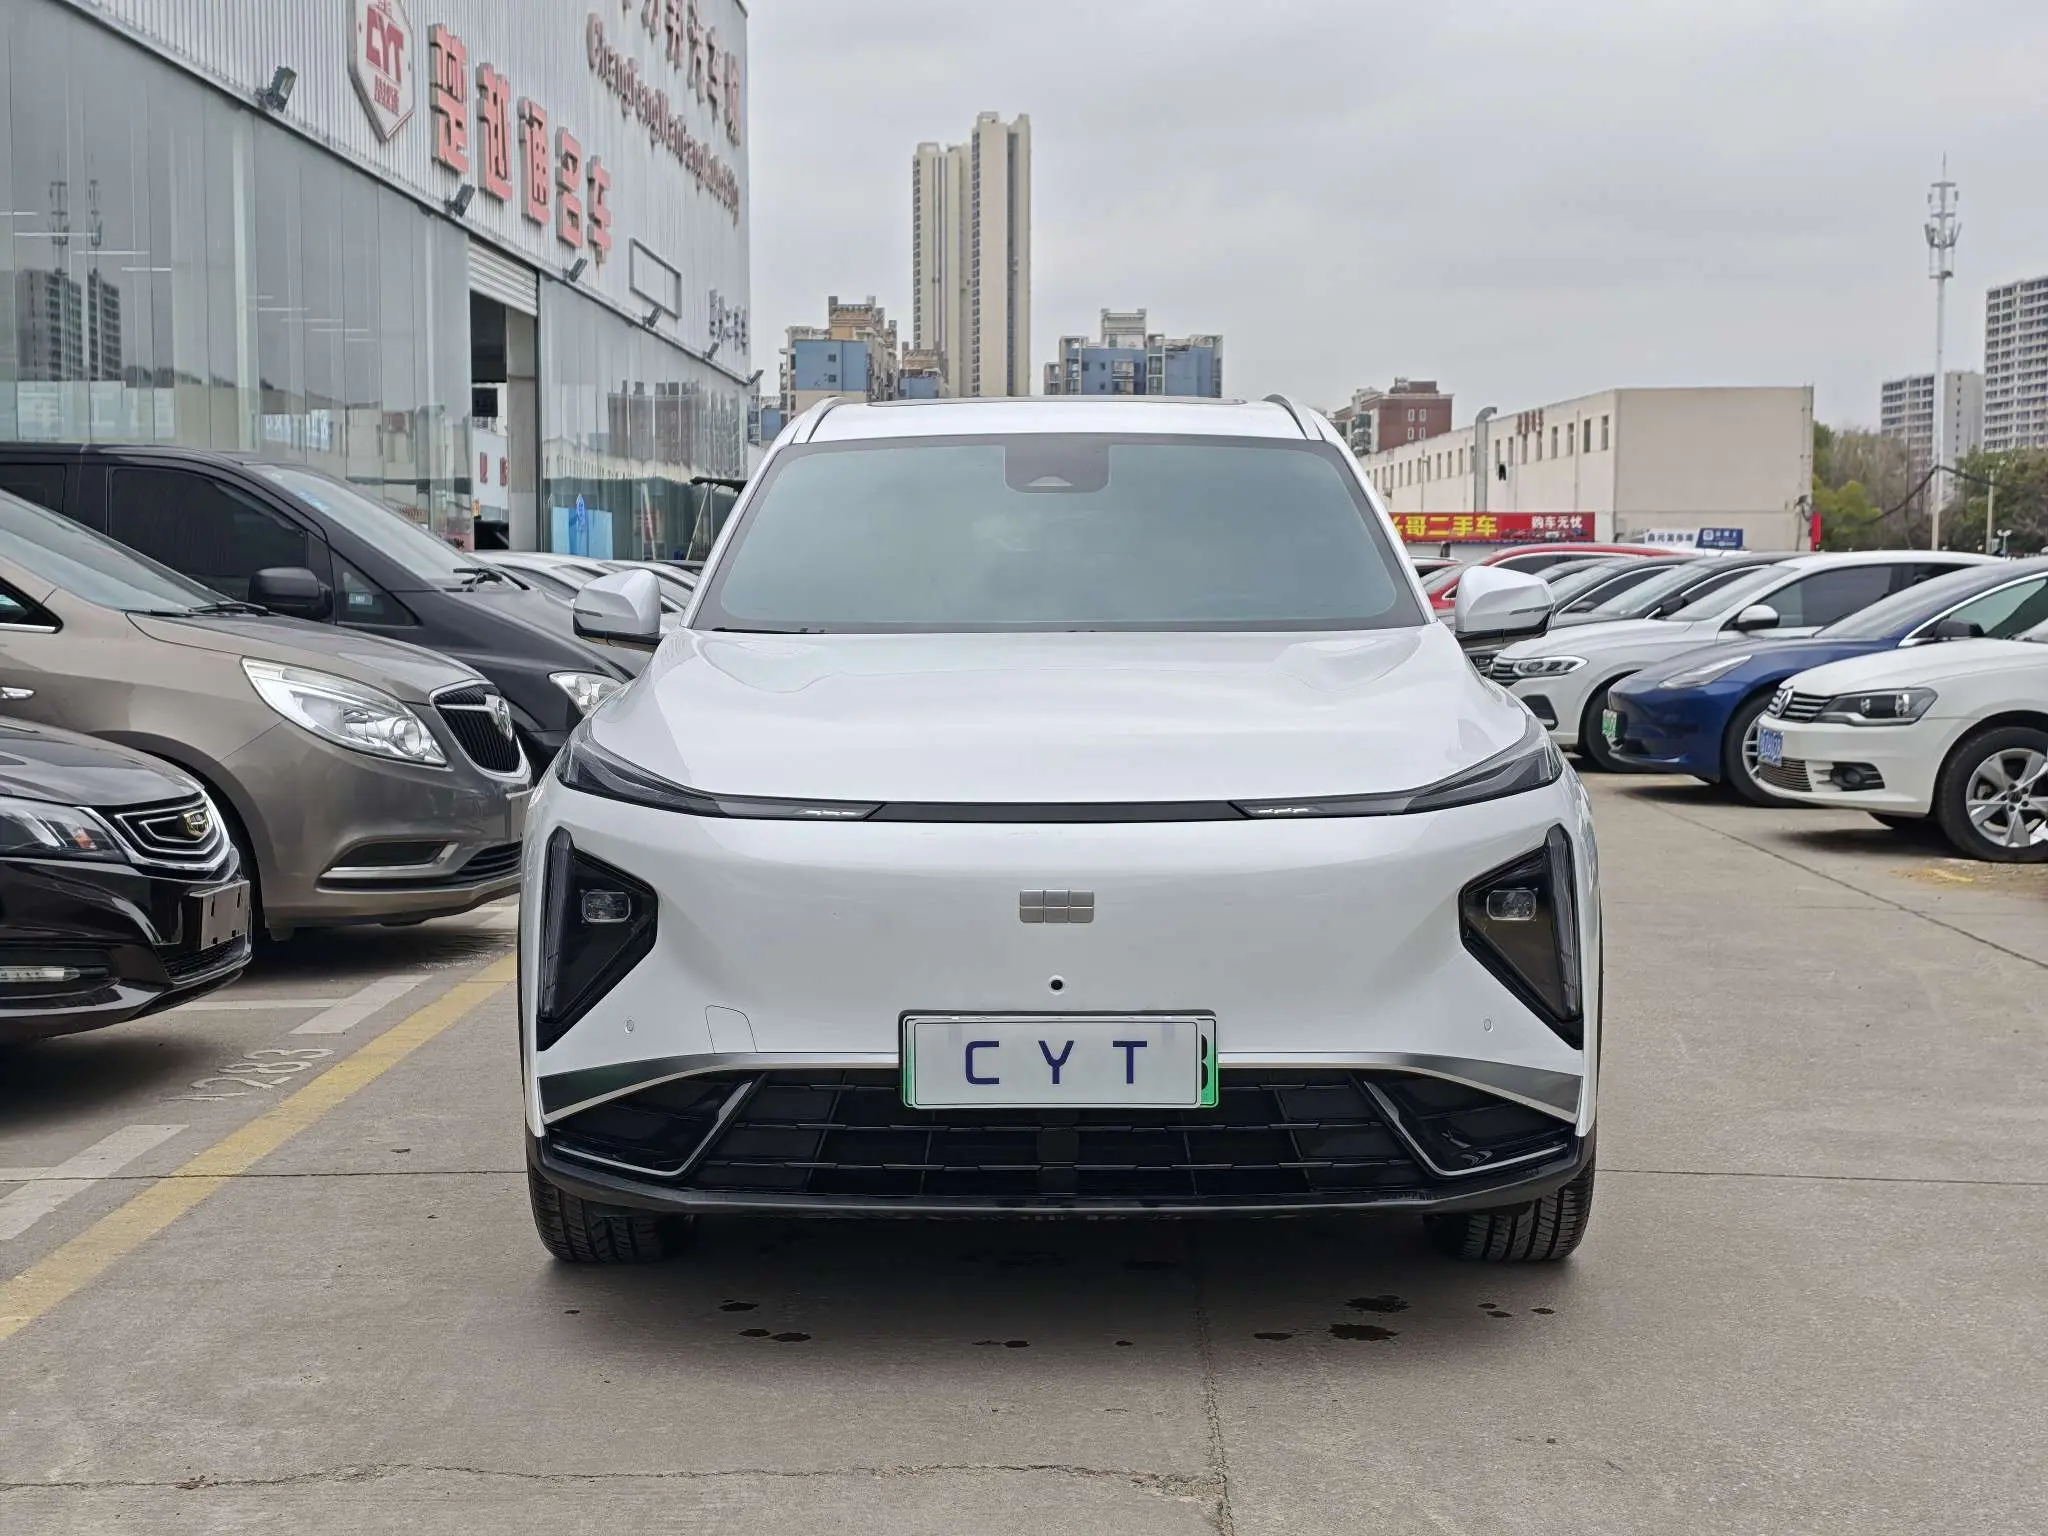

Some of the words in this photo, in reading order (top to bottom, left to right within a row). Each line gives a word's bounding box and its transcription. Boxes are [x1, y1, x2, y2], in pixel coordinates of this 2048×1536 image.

[366, 4, 404, 84] CYT
[1531, 515, 1583, 529] 购车无忧
